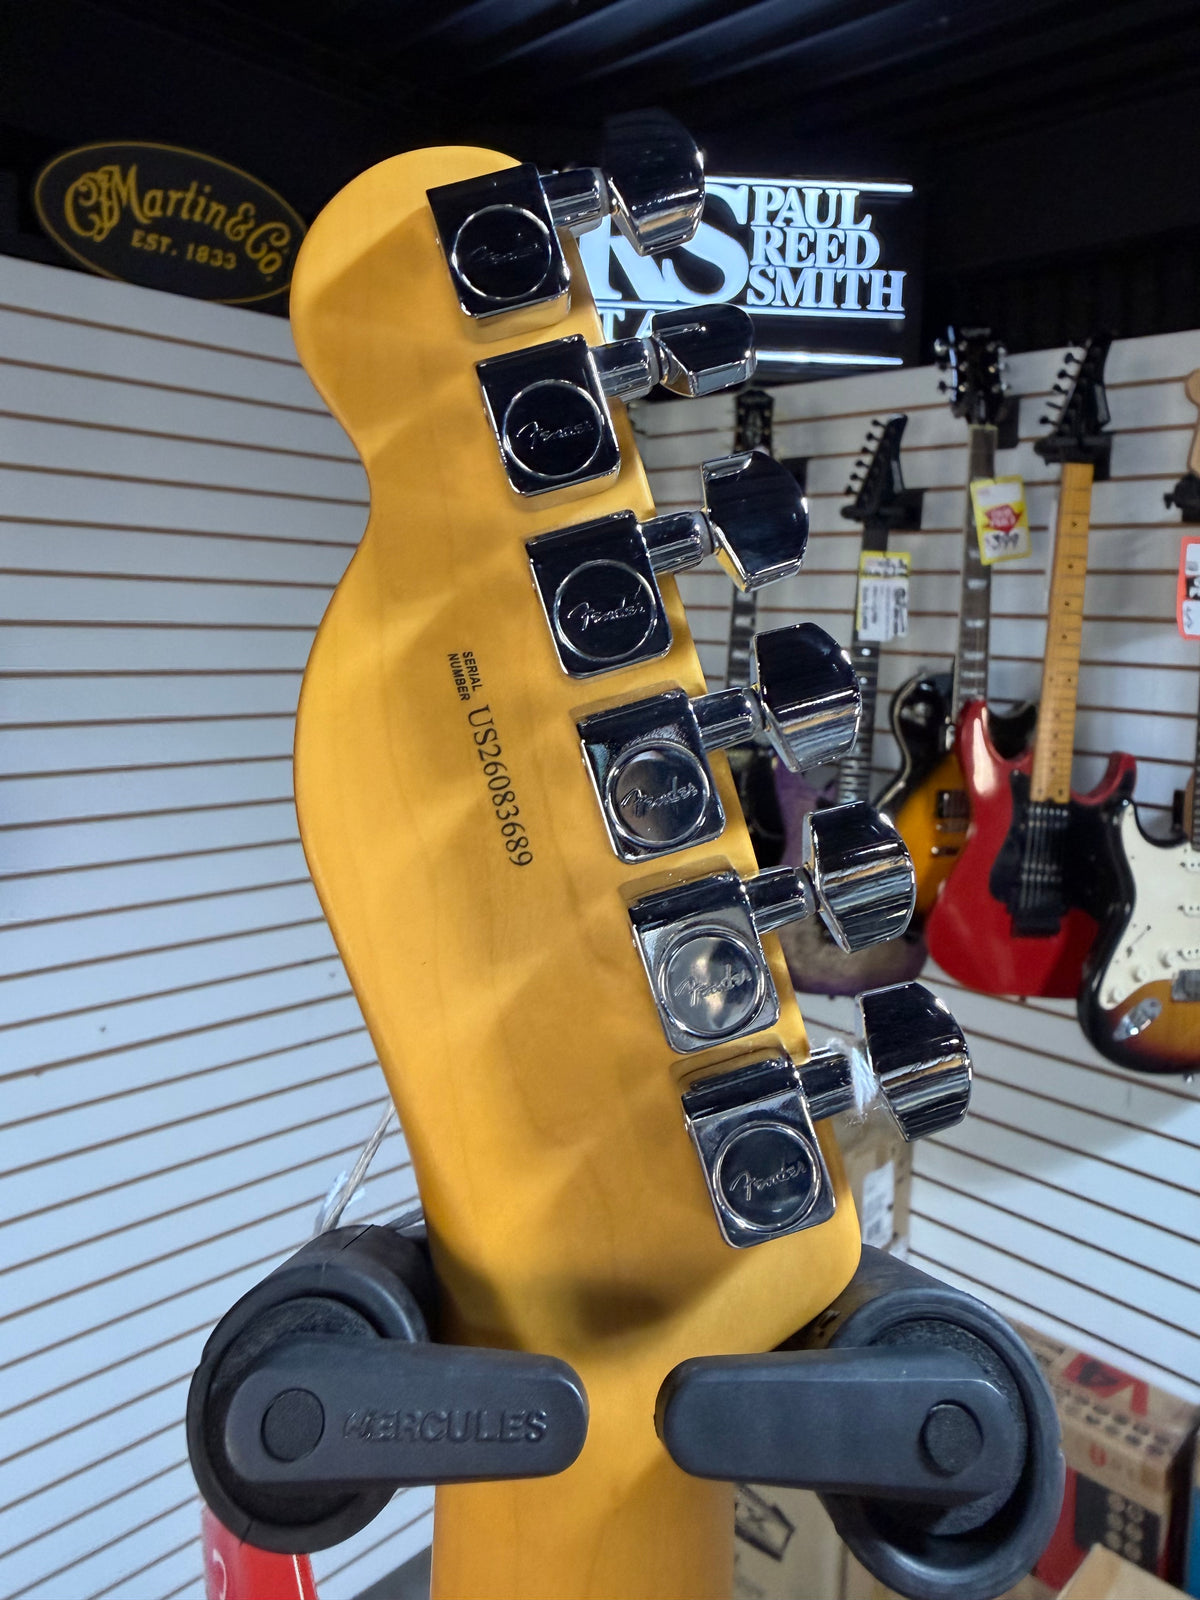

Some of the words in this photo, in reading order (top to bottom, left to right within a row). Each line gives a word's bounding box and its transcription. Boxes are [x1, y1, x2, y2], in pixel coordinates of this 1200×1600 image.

[750, 184, 873, 231] PAUL
[130, 228, 178, 256] EST.
[186, 242, 238, 270] 1833
[750, 226, 881, 270] REED
[746, 264, 907, 312] SMITH
[566, 596, 646, 632] Fender
[447, 652, 471, 702] NUMBER
[462, 651, 483, 692] SERIAL
[467, 704, 534, 867] US26083689
[620, 775, 699, 817] Fender
[673, 963, 753, 1007] Fender
[729, 1156, 807, 1201] Fender
[343, 1408, 548, 1443] HERCULES
